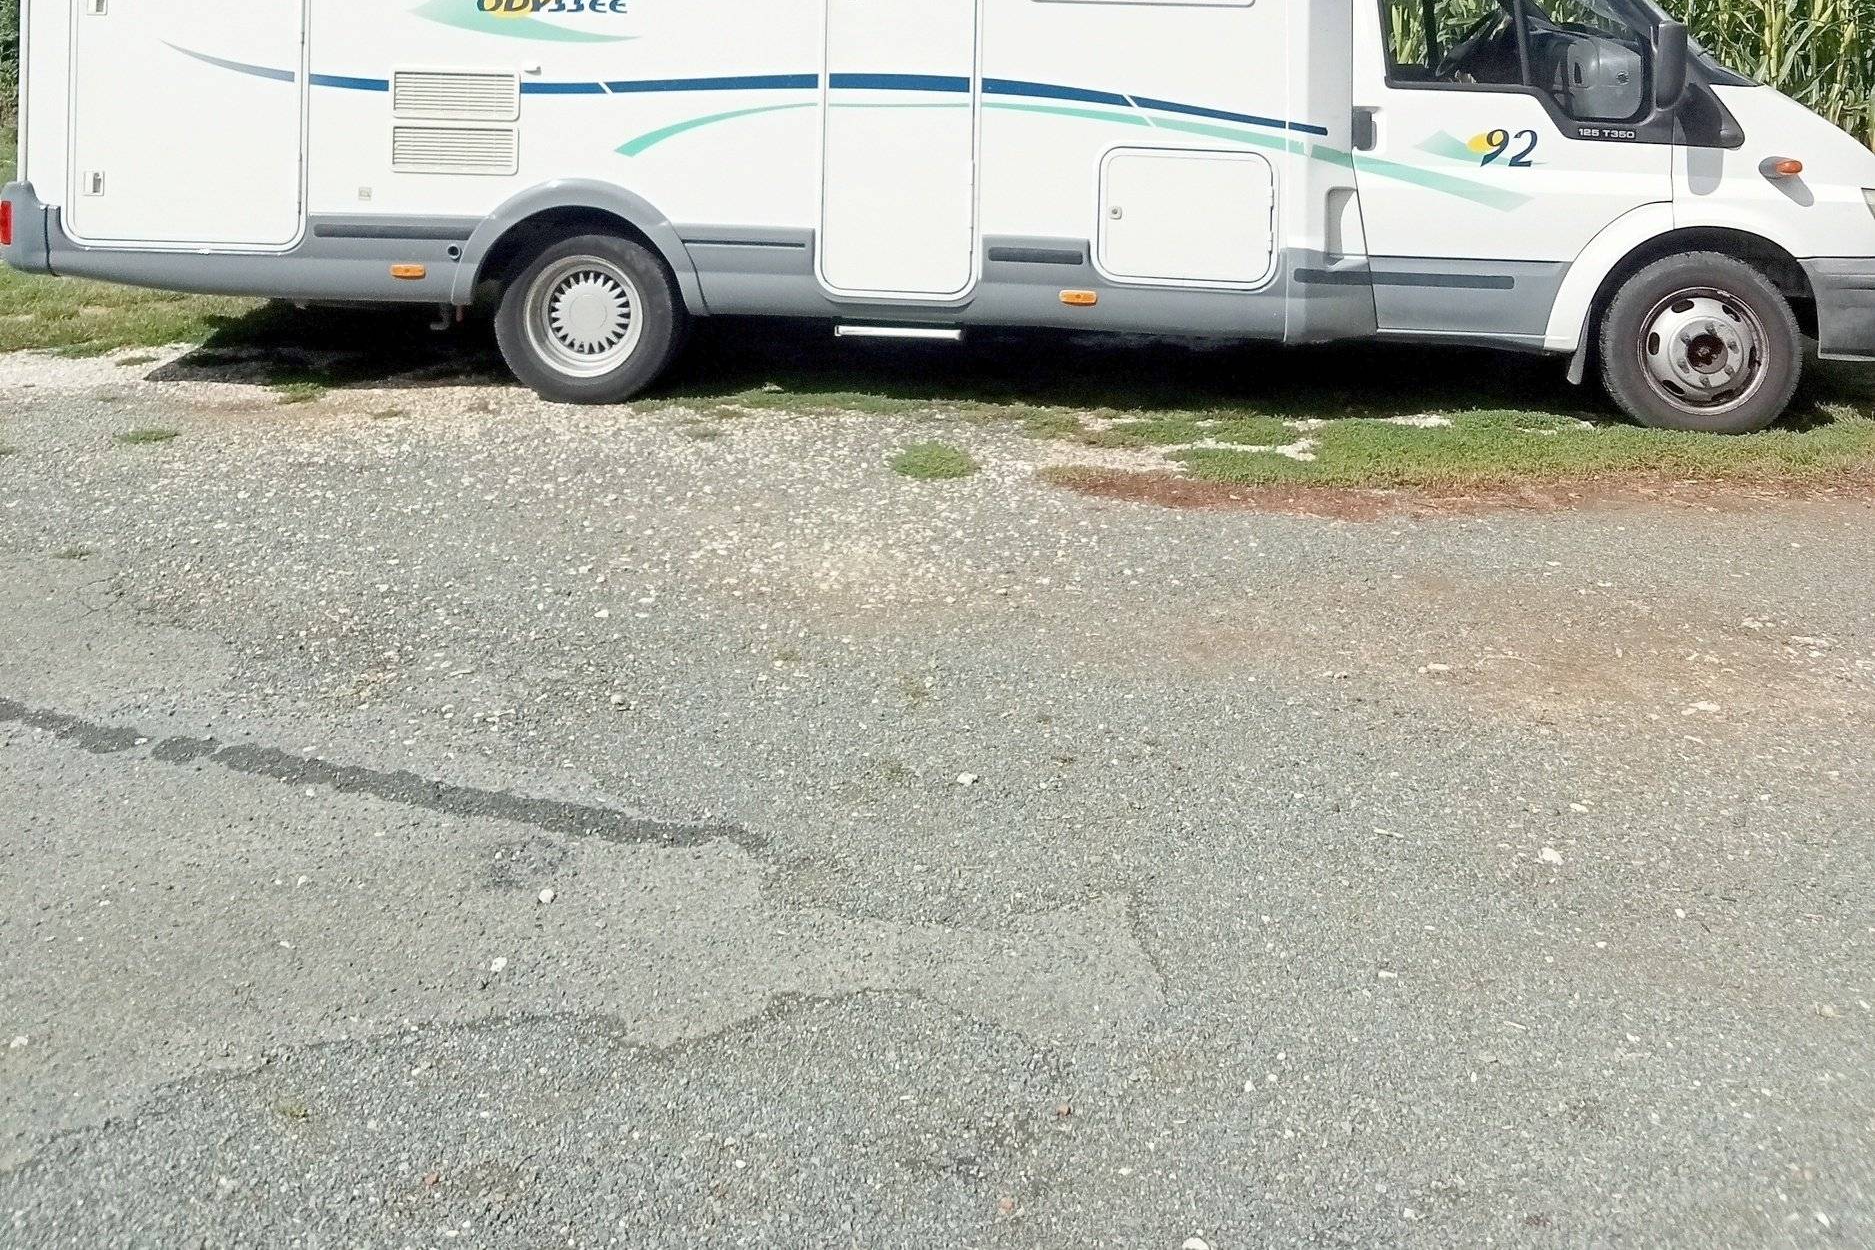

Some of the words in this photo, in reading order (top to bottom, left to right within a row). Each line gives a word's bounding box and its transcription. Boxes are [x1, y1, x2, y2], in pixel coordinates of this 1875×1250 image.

[1579, 128, 1600, 137] 125
[1602, 129, 1635, 139] T350
[1480, 128, 1538, 167] 92
